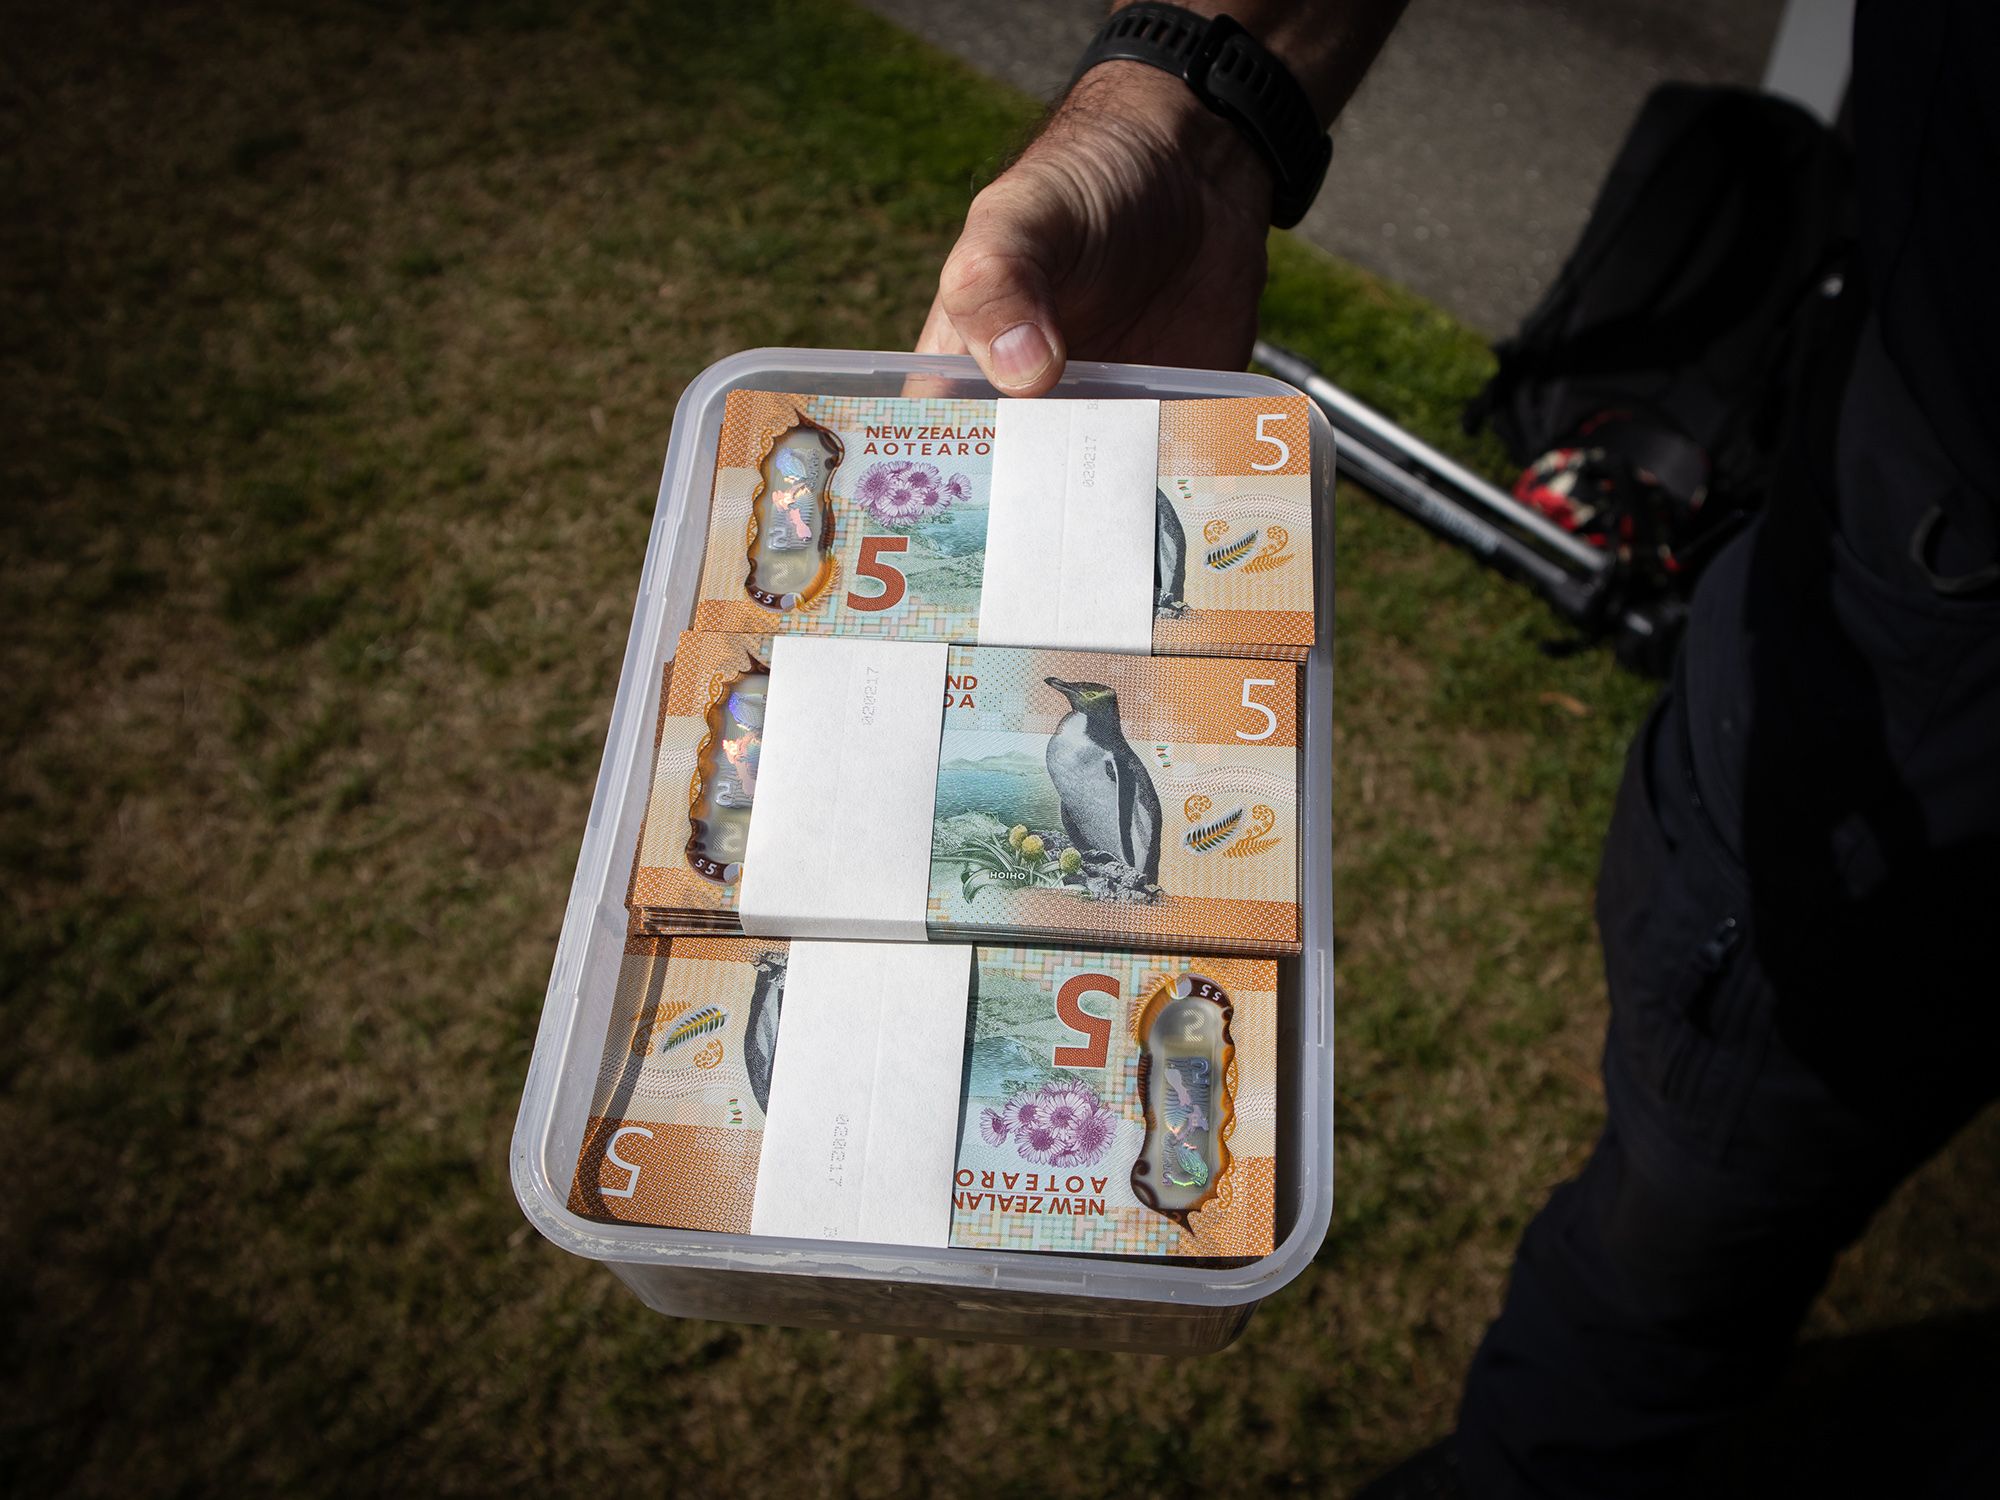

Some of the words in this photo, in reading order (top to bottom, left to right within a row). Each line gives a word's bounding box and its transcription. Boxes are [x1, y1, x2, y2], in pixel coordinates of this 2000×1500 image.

[865, 426, 912, 440] NEW
[917, 426, 995, 440] ZEALAN
[1251, 414, 1290, 471] 5
[864, 442, 991, 456] AOTEARO
[846, 536, 908, 612] 5
[1236, 678, 1277, 740] 5
[990, 871, 1026, 880] HOIHO
[1054, 973, 1121, 1069] 5
[600, 1127, 653, 1198] 5
[955, 1168, 1108, 1194] AOTEARO
[952, 1191, 1044, 1213] ZEALAN
[1048, 1196, 1106, 1216] NEW
